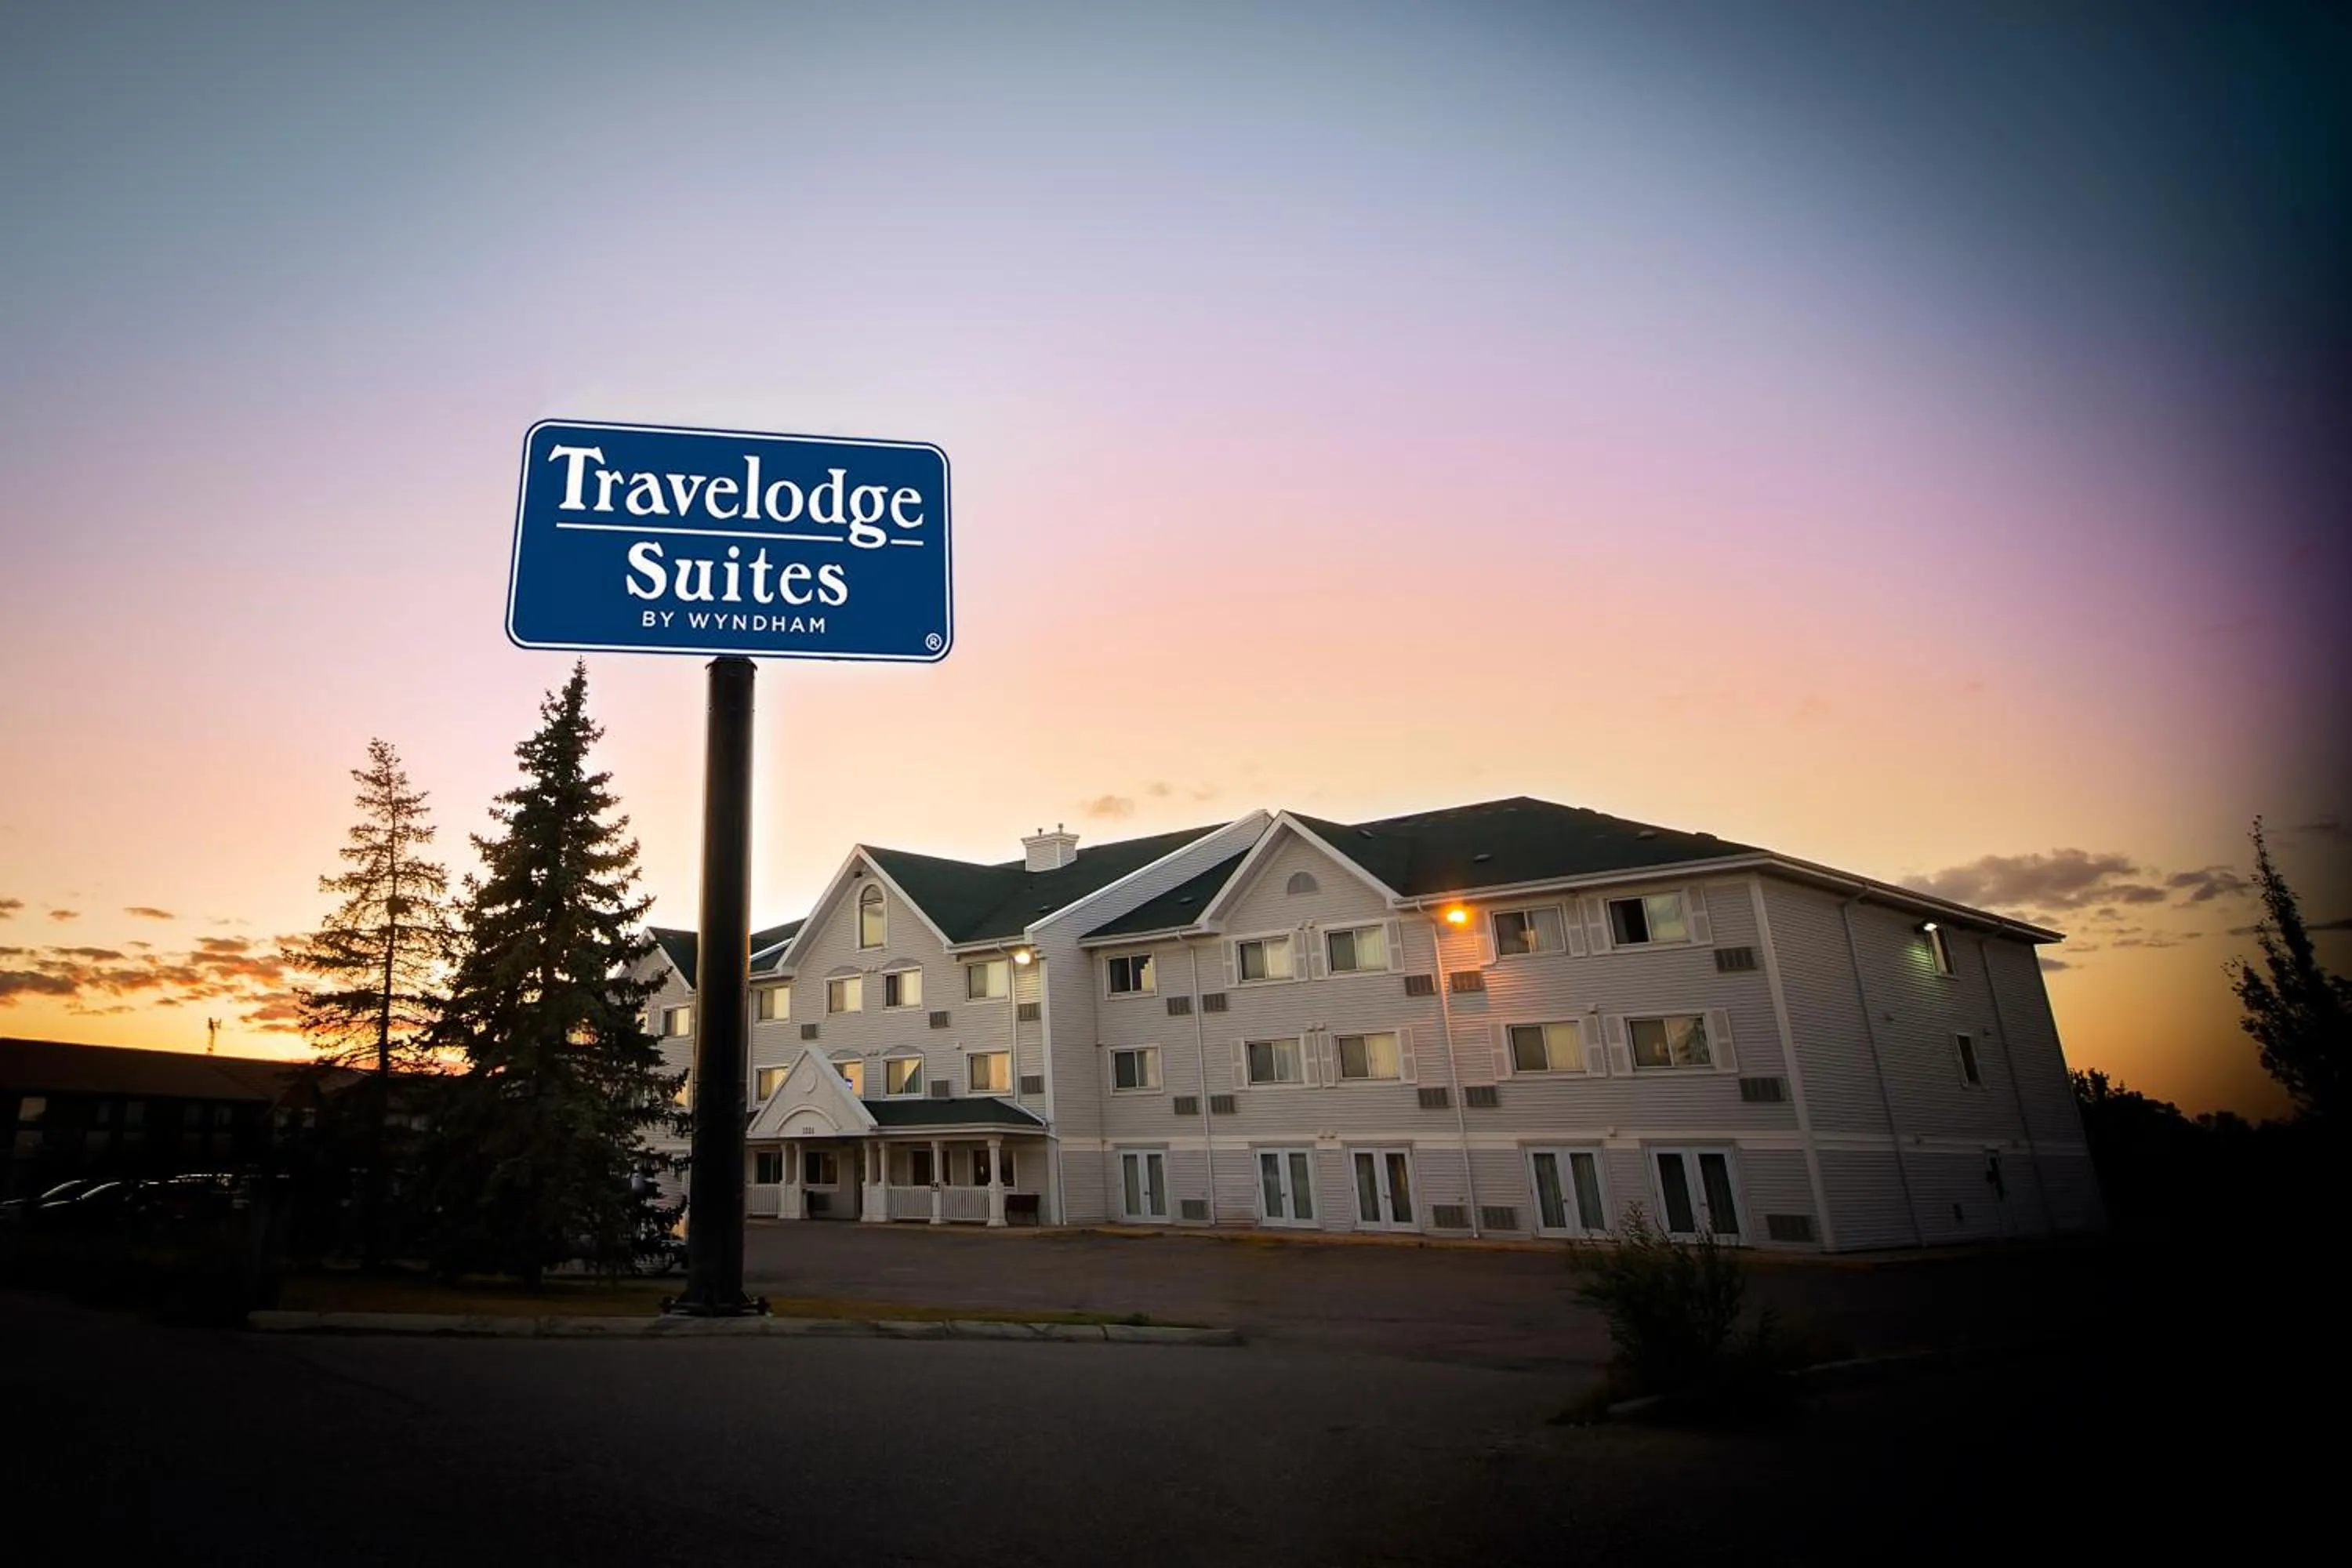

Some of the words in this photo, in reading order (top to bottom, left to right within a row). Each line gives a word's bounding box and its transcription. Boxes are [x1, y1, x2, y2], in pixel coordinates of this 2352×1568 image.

[548, 445, 924, 549] Travelodge
[626, 541, 848, 606] Suites
[641, 611, 675, 628] BY
[688, 612, 826, 633] WYNDHAM
